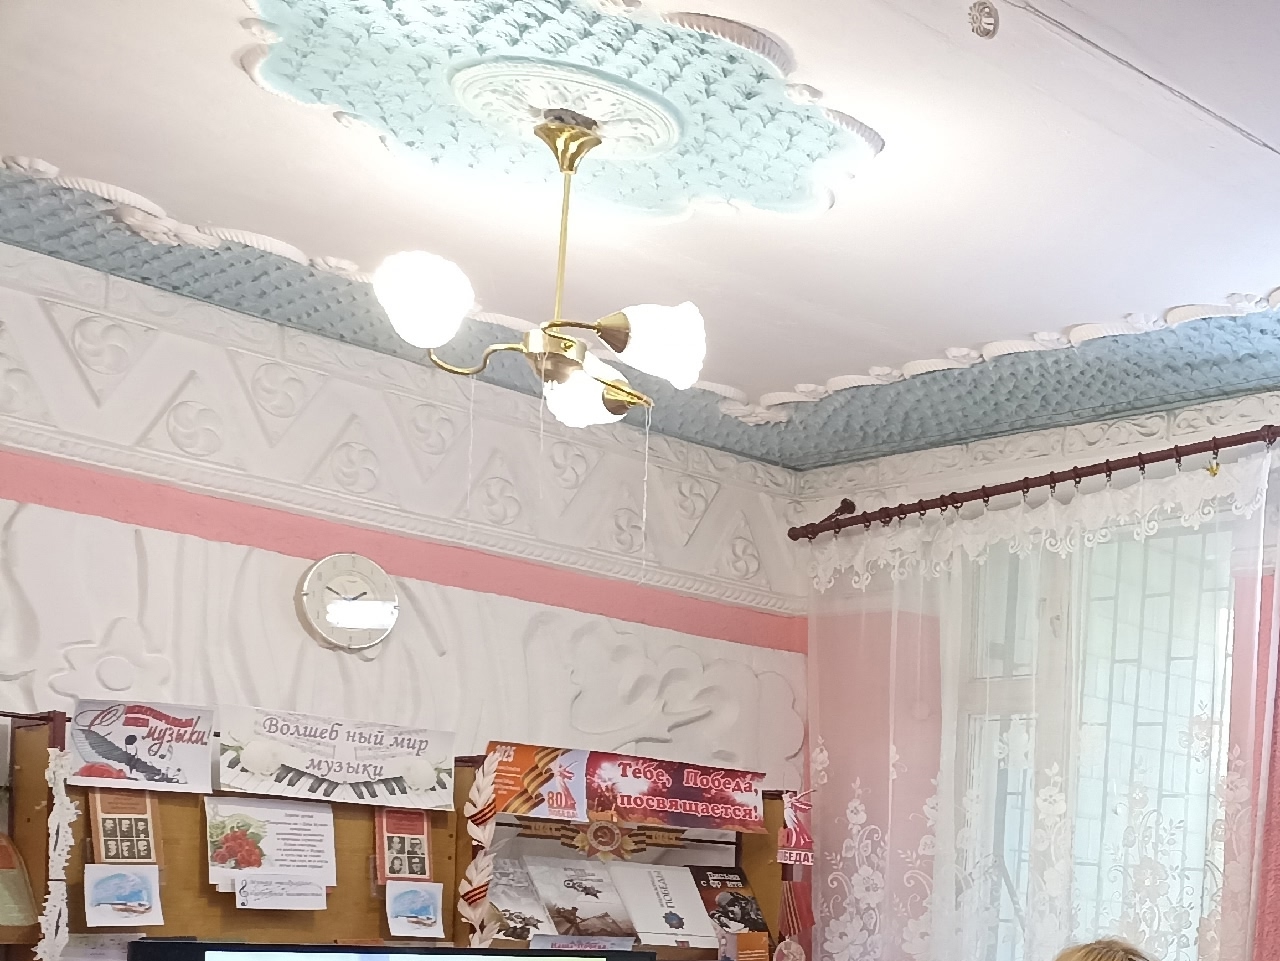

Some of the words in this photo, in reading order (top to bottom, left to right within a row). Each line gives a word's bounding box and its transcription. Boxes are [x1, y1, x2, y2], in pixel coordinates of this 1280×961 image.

[262, 716, 343, 741] Волшеб
[345, 729, 385, 746] ный
[389, 735, 429, 757] мир
[305, 757, 384, 781] музыки
[617, 761, 673, 788] Тебе,
[683, 768, 759, 797] Победа,
[546, 791, 565, 809] 80
[616, 792, 759, 821] посвящается!
